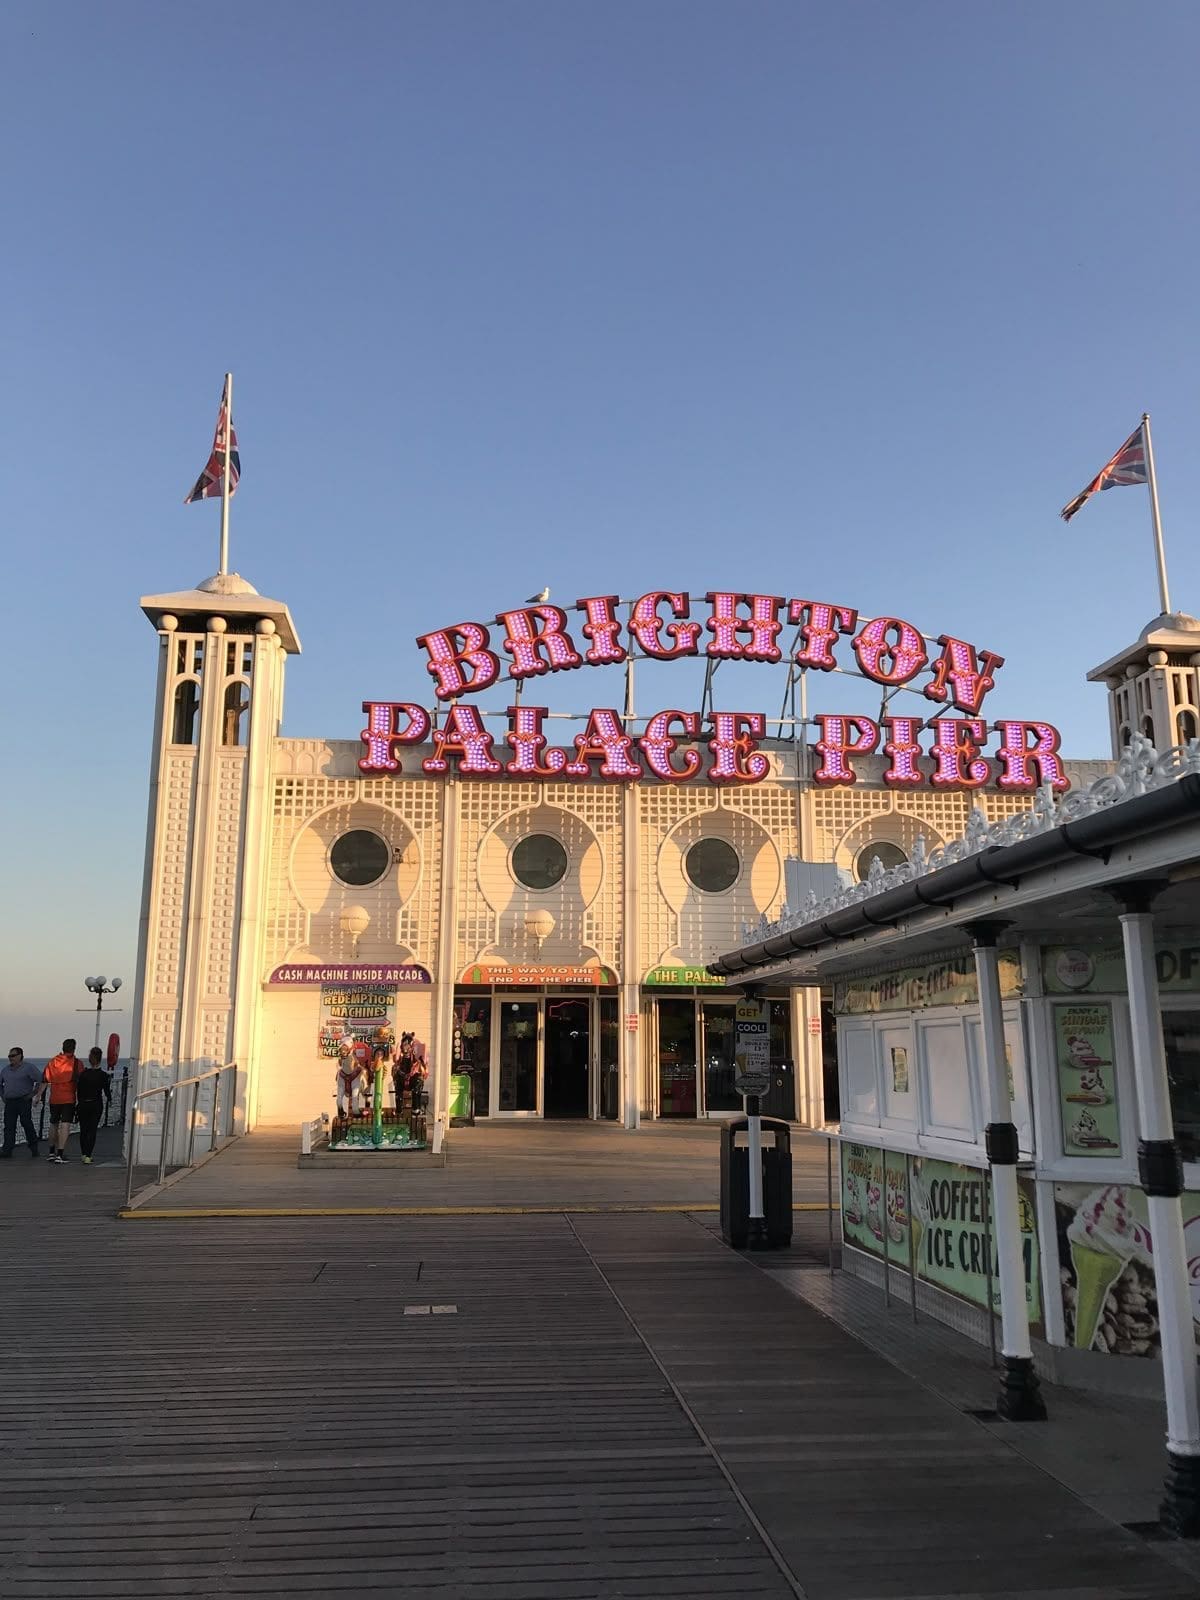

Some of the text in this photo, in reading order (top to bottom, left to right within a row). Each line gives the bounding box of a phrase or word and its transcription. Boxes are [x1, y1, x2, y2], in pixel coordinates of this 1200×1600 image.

[416, 591, 1004, 715] BRIGHTON
[358, 701, 1072, 793] PALACE PIER
[278, 969, 423, 981] CASH MACHINE INSIDE ARCADE
[573, 967, 594, 975] THE
[654, 970, 678, 982] THE
[323, 987, 345, 996] COME
[323, 993, 395, 1006] REDEMPTION
[330, 1005, 387, 1018] MACHINES
[738, 1008, 758, 1017] GET
[737, 1023, 765, 1033] COOL!
[930, 1178, 992, 1225] COFFEE
[927, 1227, 955, 1269] ICE
